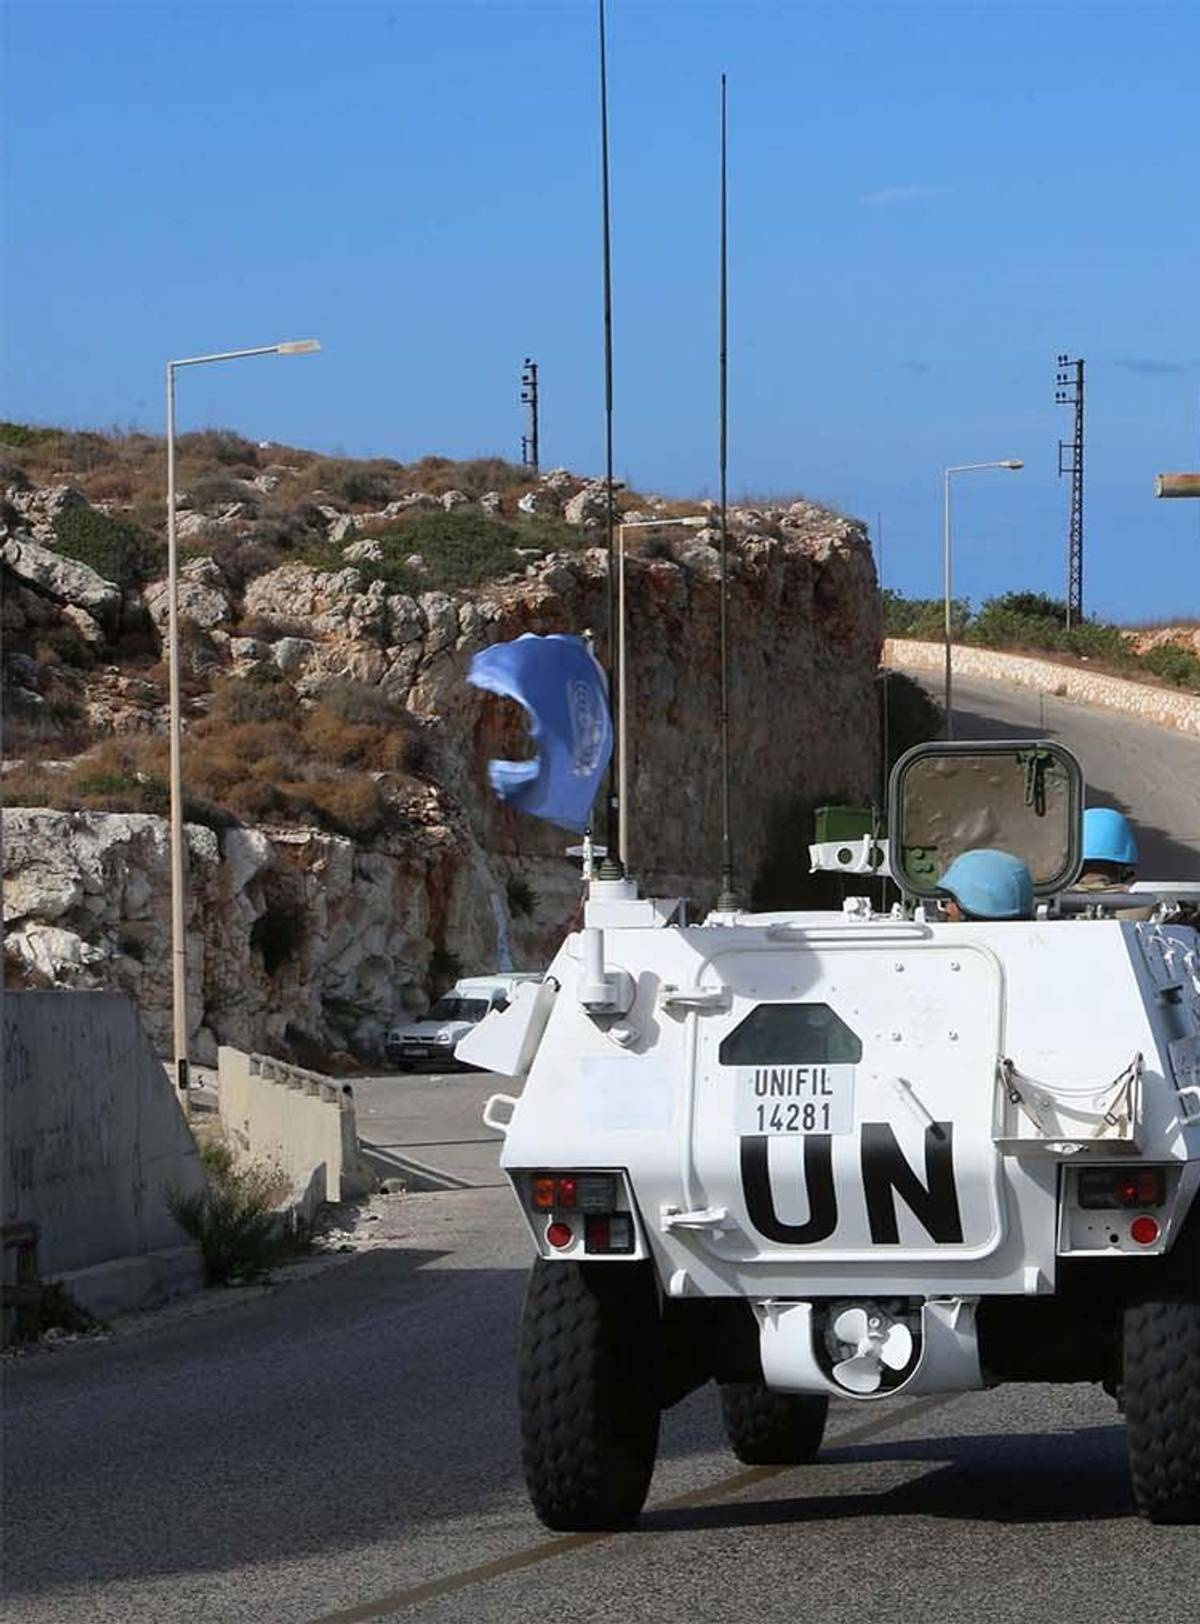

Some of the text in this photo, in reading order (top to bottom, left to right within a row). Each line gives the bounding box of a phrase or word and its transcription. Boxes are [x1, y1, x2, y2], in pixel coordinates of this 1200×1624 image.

[753, 1066, 834, 1098] UNIFIL
[756, 1103, 832, 1133] 14281
[740, 1122, 965, 1246] UN
